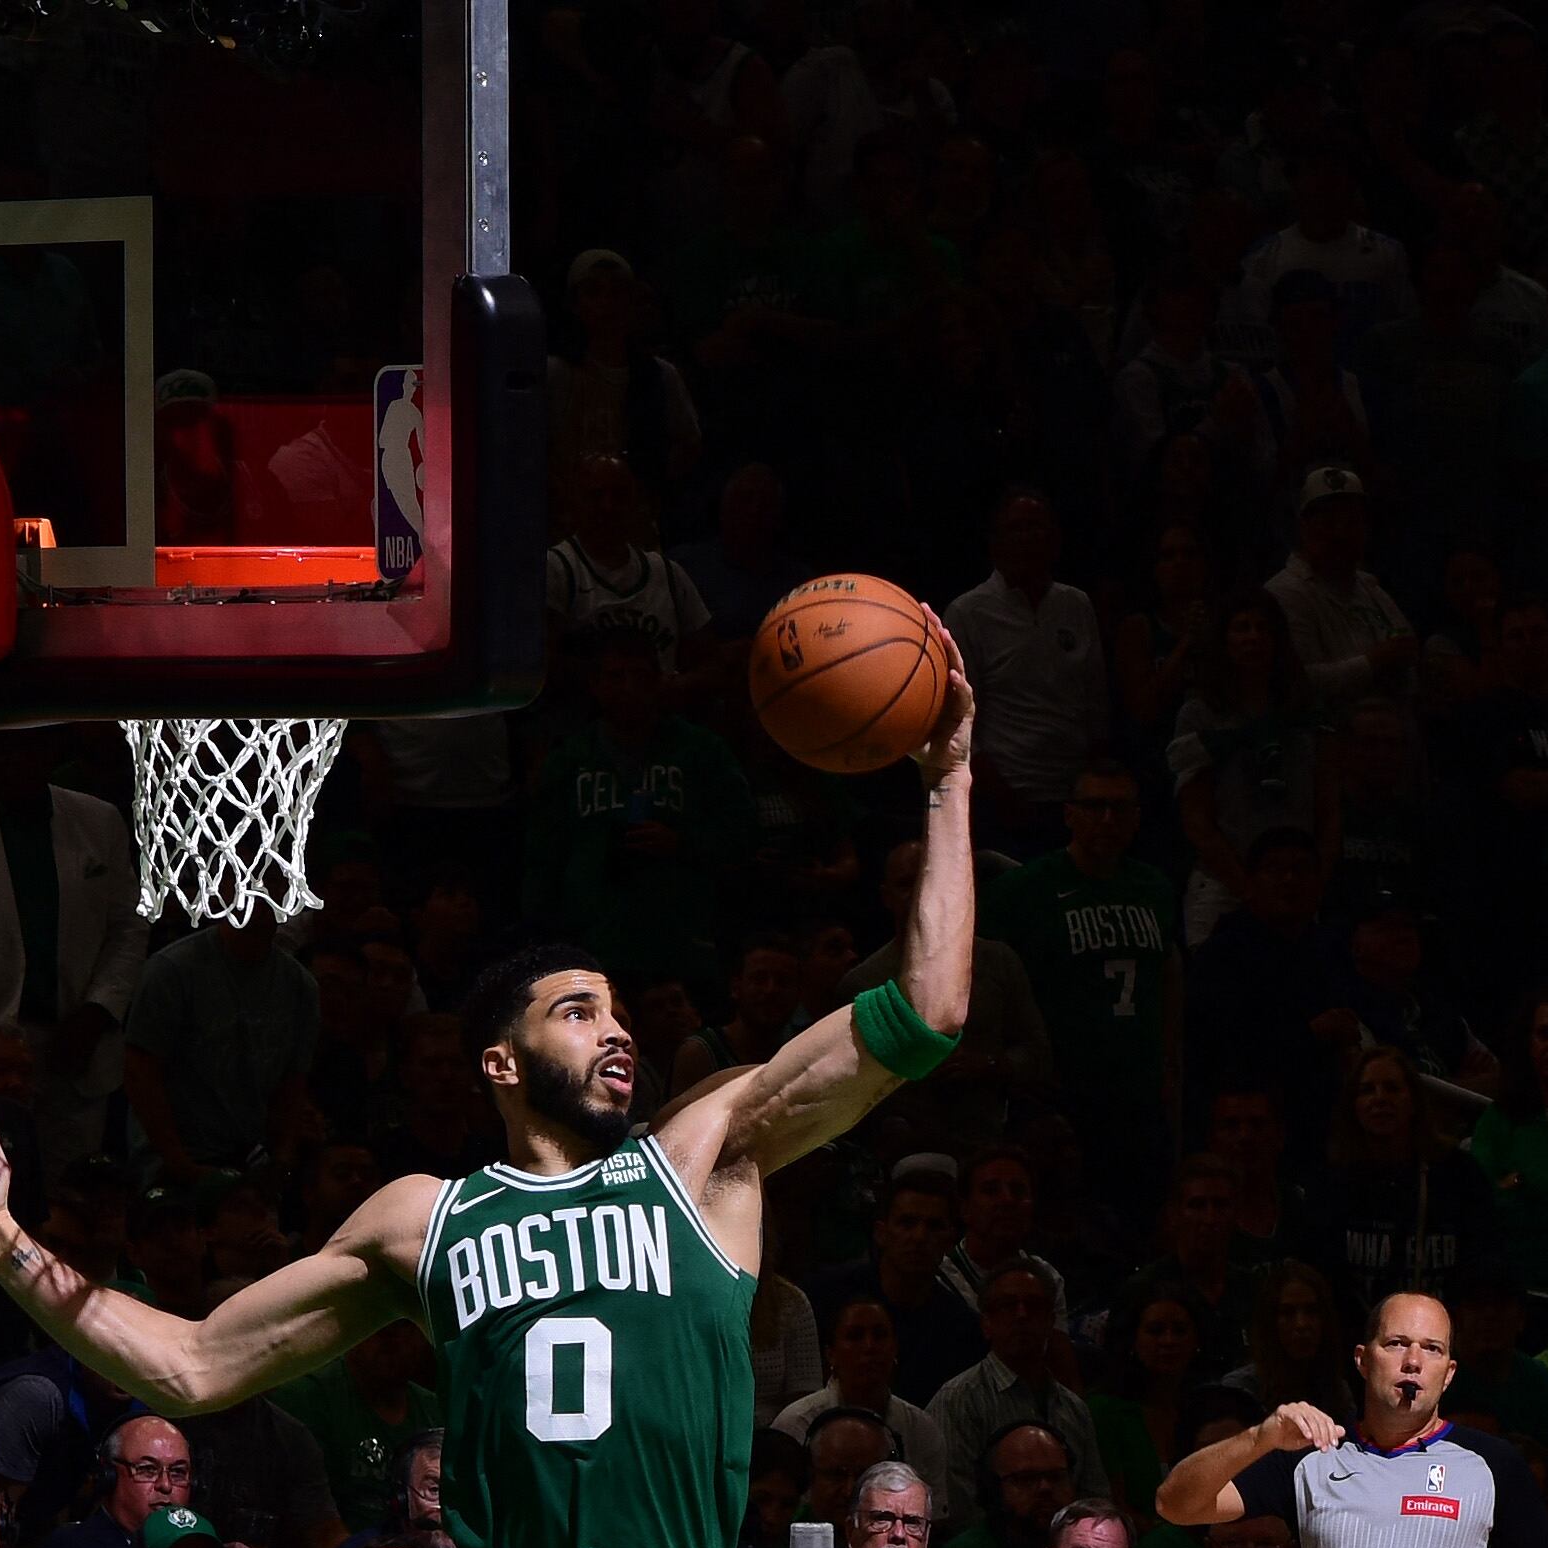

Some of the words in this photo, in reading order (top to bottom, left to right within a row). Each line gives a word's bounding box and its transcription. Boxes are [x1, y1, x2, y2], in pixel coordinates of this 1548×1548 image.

[385, 535, 415, 569] NBA
[576, 764, 684, 818] CELICS
[1065, 904, 1164, 955] BOSTON
[1103, 959, 1138, 1017] 7
[601, 1166, 647, 1186] PRINT
[446, 1203, 673, 1332] BOSTON
[524, 1316, 613, 1443] 0
[1406, 1500, 1455, 1514] Emirates
